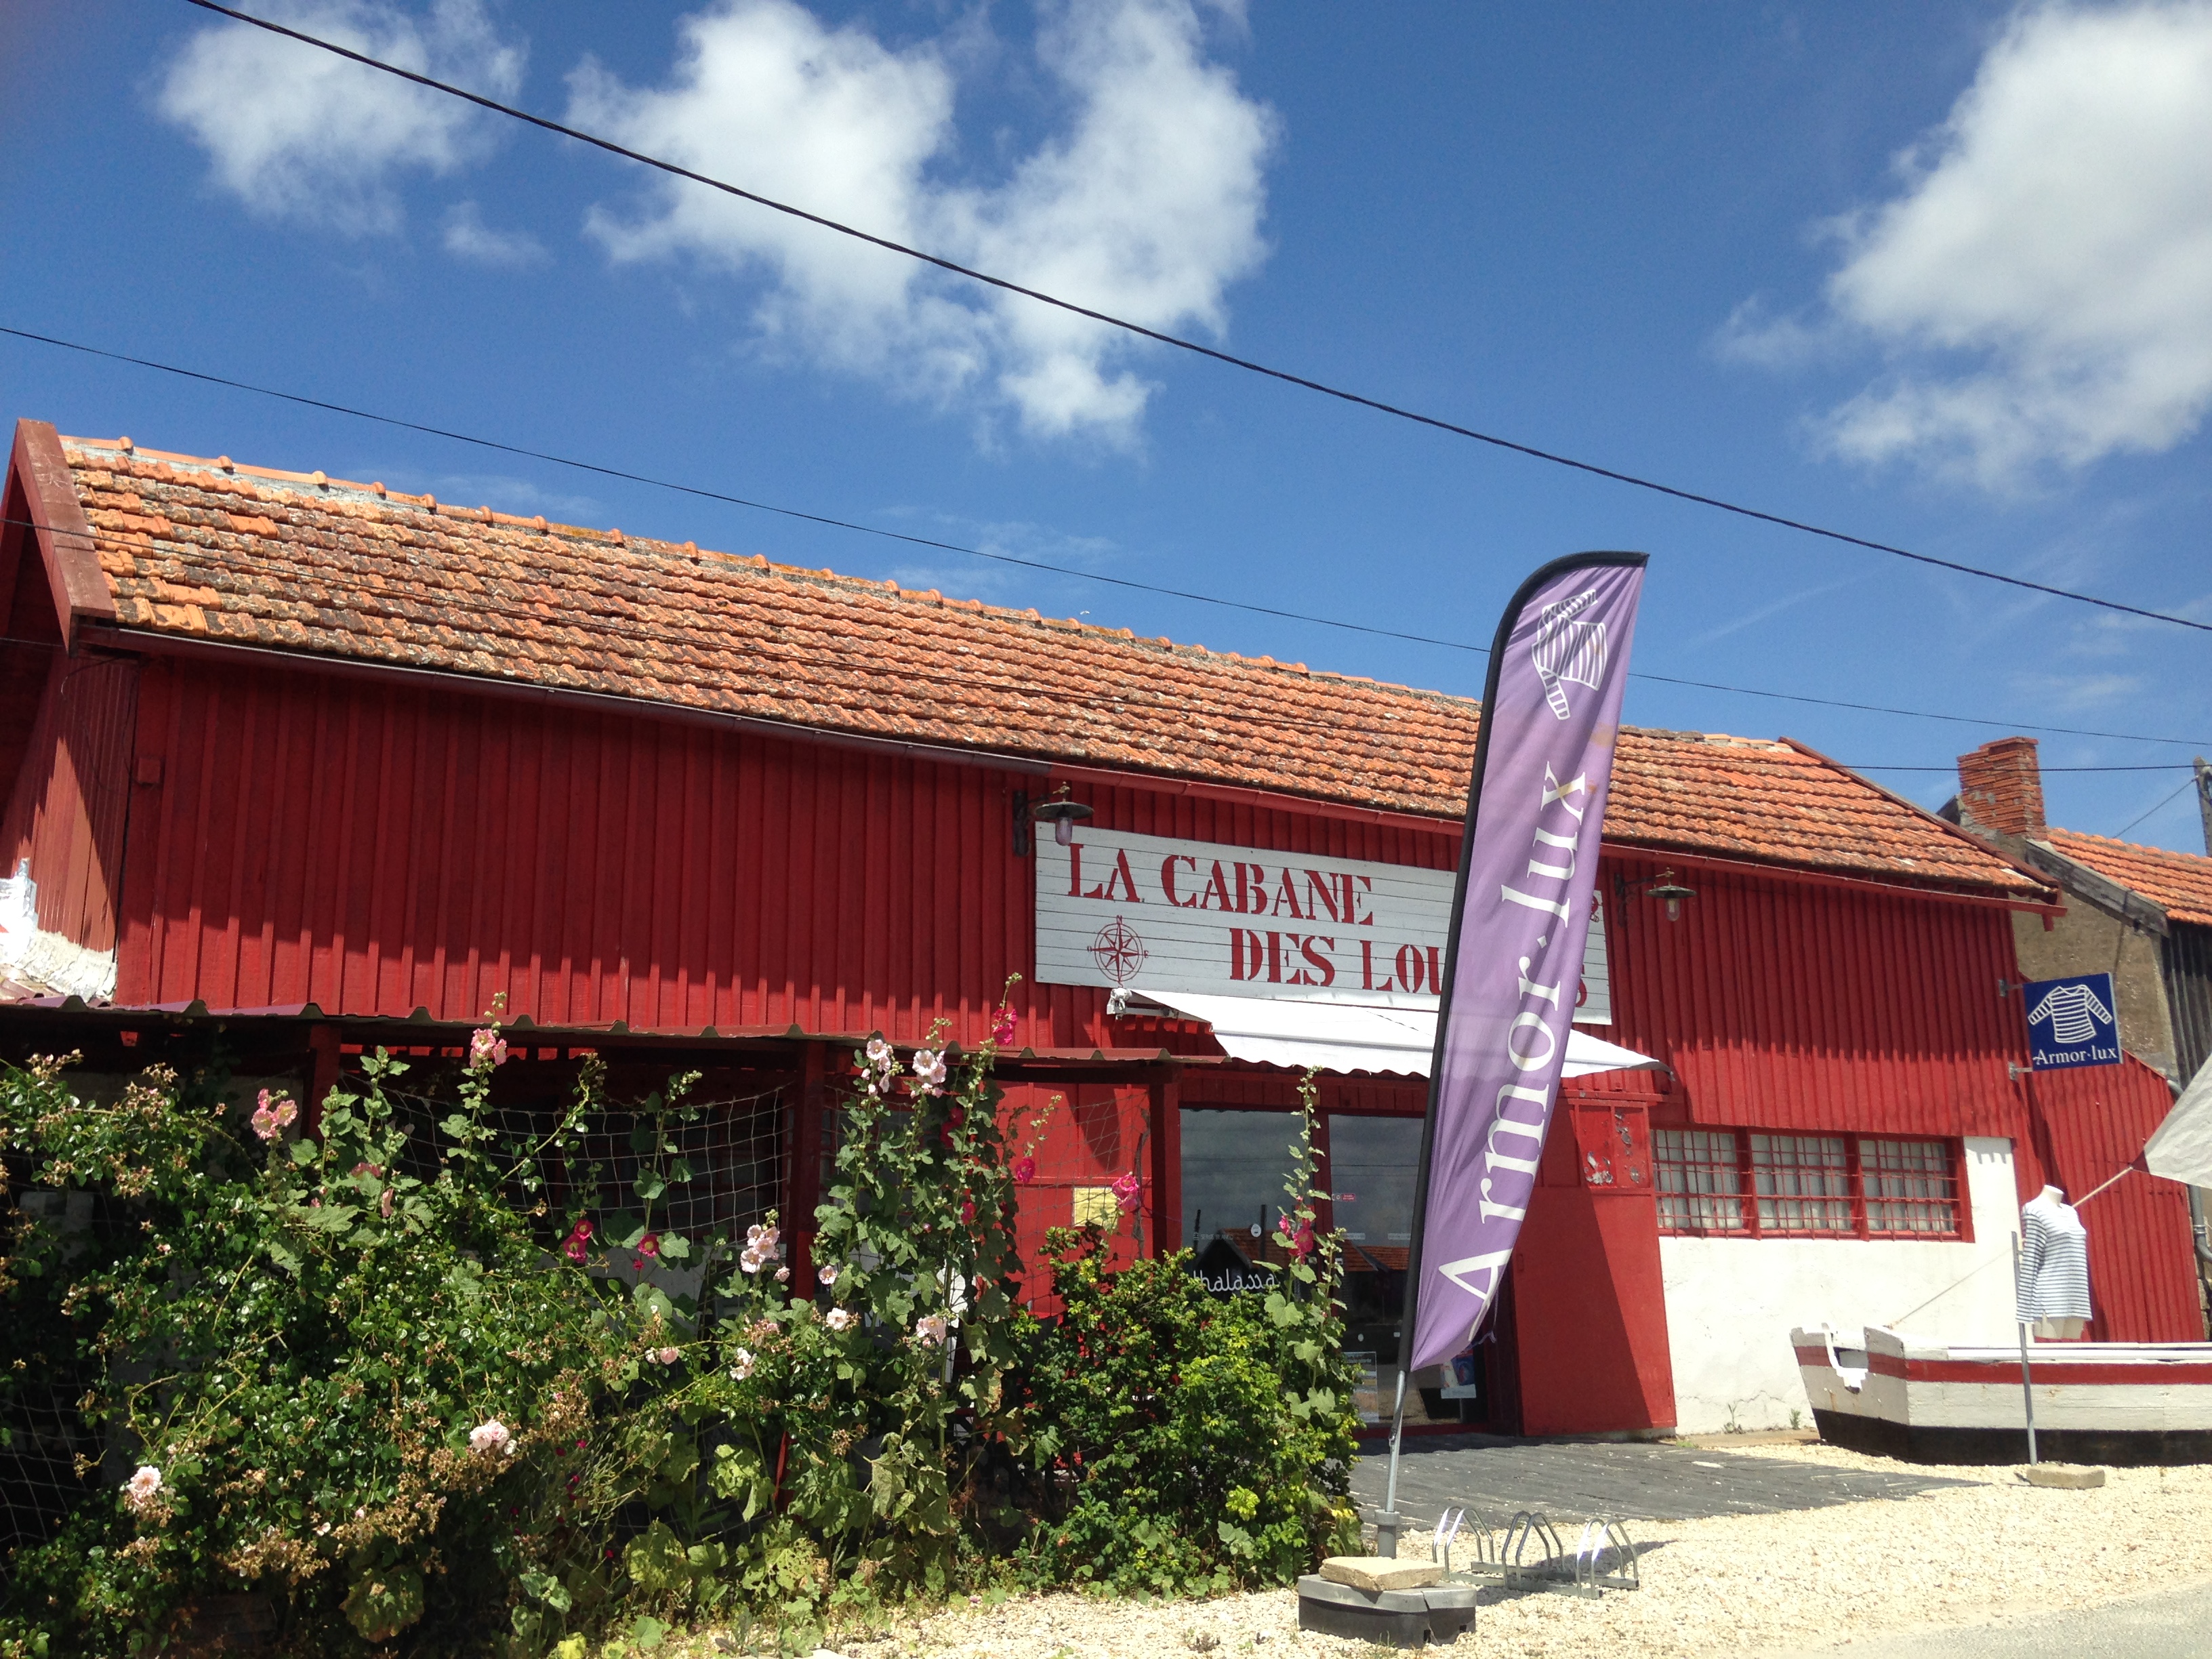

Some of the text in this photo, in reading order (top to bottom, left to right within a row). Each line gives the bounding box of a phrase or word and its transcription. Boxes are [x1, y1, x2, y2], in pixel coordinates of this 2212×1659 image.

[1067, 842, 1374, 926] LA CABANE
[1229, 927, 1336, 987] DES
